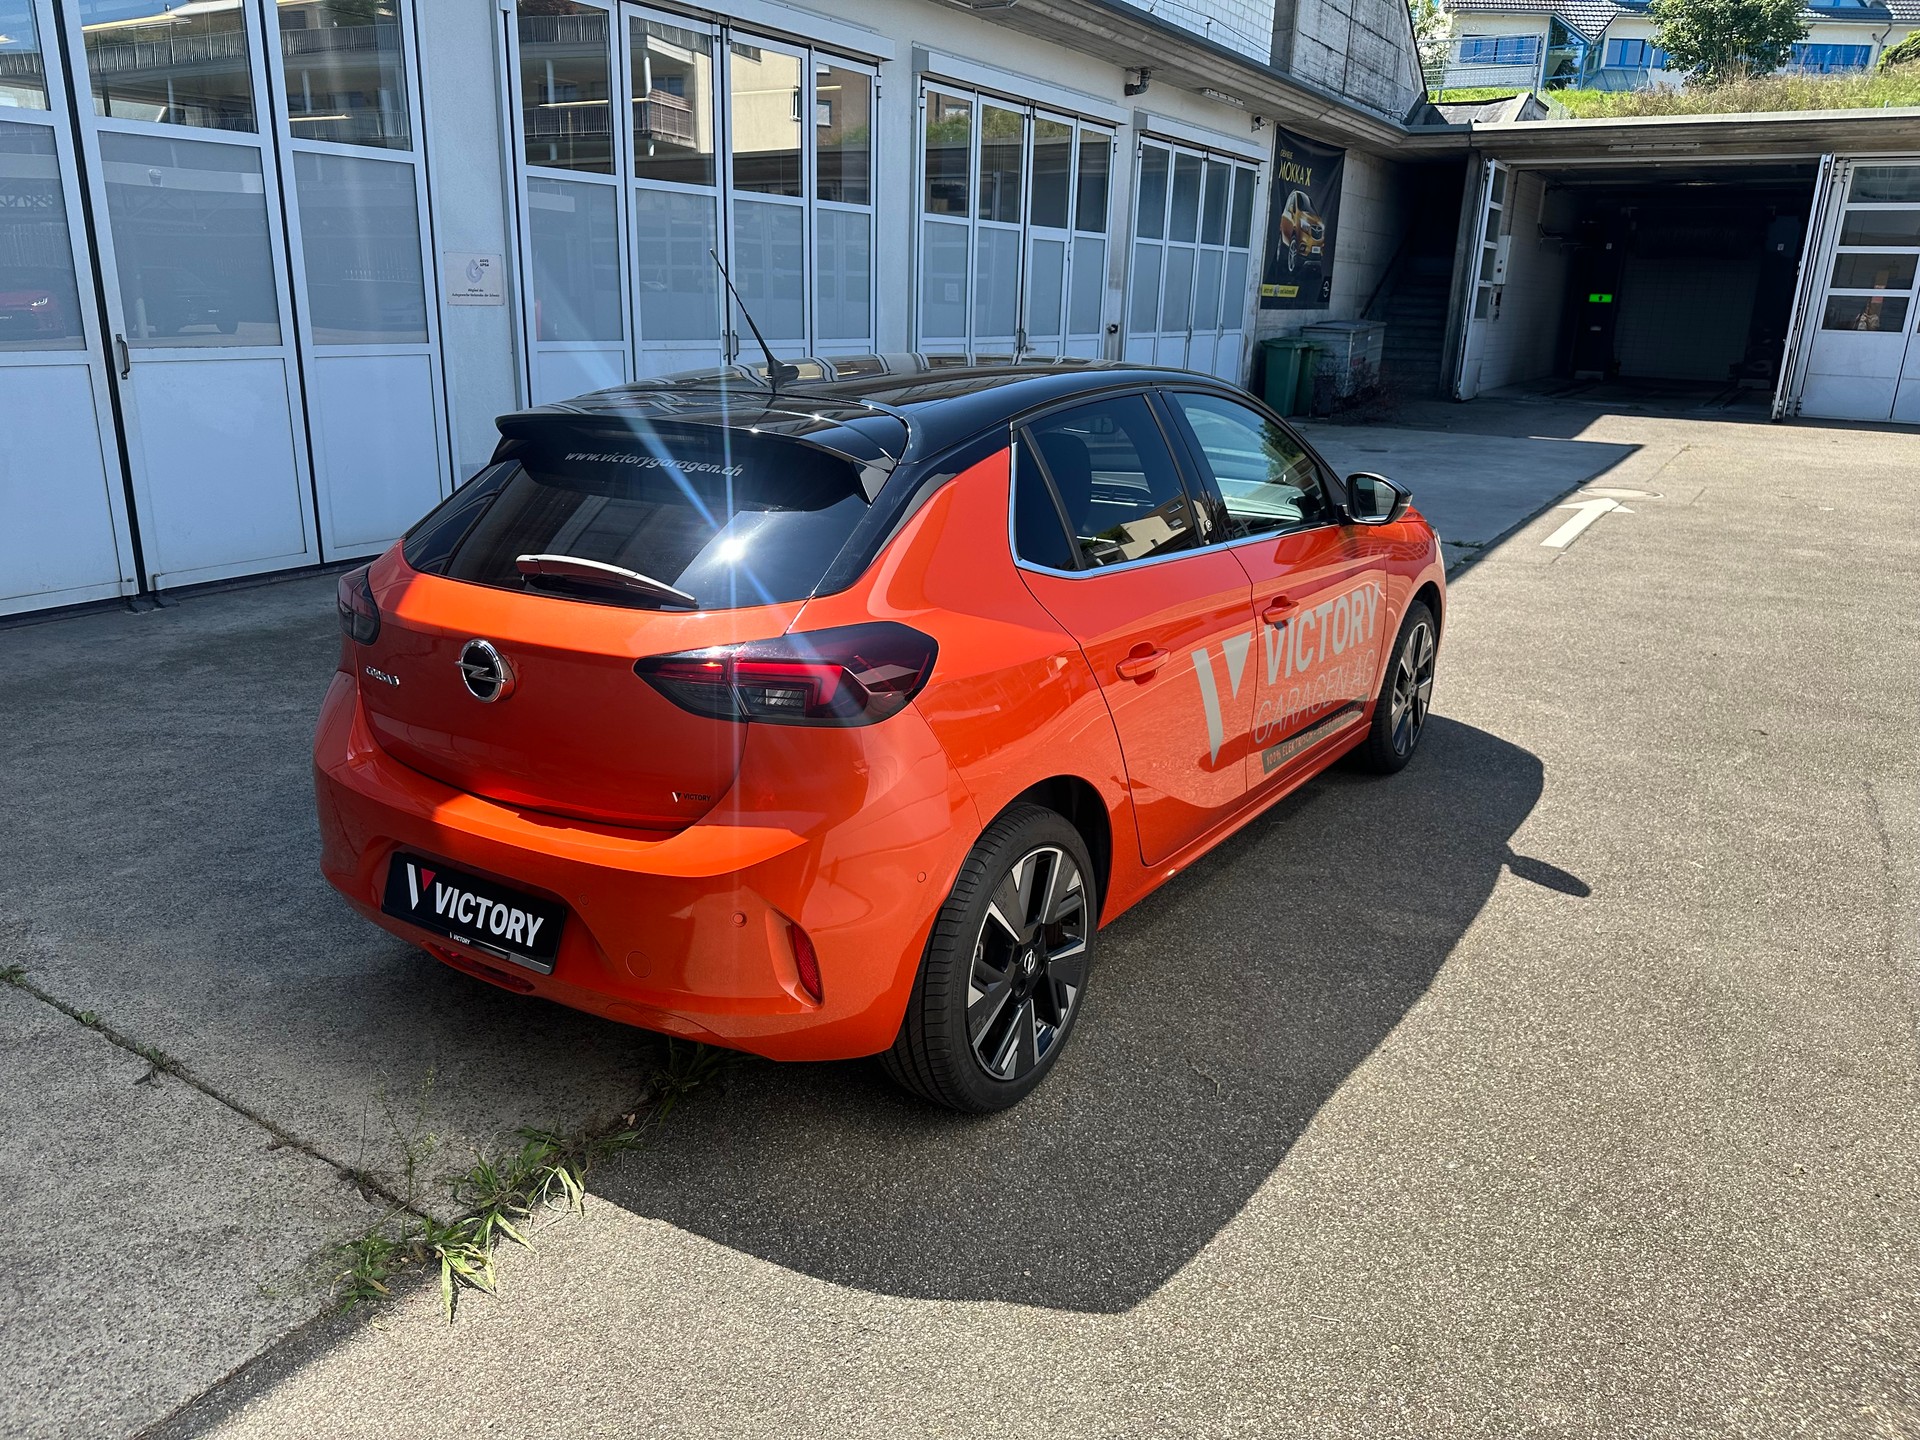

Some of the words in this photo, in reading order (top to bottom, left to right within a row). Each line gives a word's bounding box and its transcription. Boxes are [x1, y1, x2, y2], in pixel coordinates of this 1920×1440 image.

[1278, 160, 1304, 185] MOKKA
[1304, 167, 1312, 187] X
[564, 451, 744, 477] www.victorygaragen.ch
[1264, 581, 1379, 686] VICTORY
[1254, 662, 1349, 744] GARAGEN
[1350, 649, 1375, 689] AG
[683, 792, 712, 802] VICTORY
[435, 881, 545, 948] VICTORY
